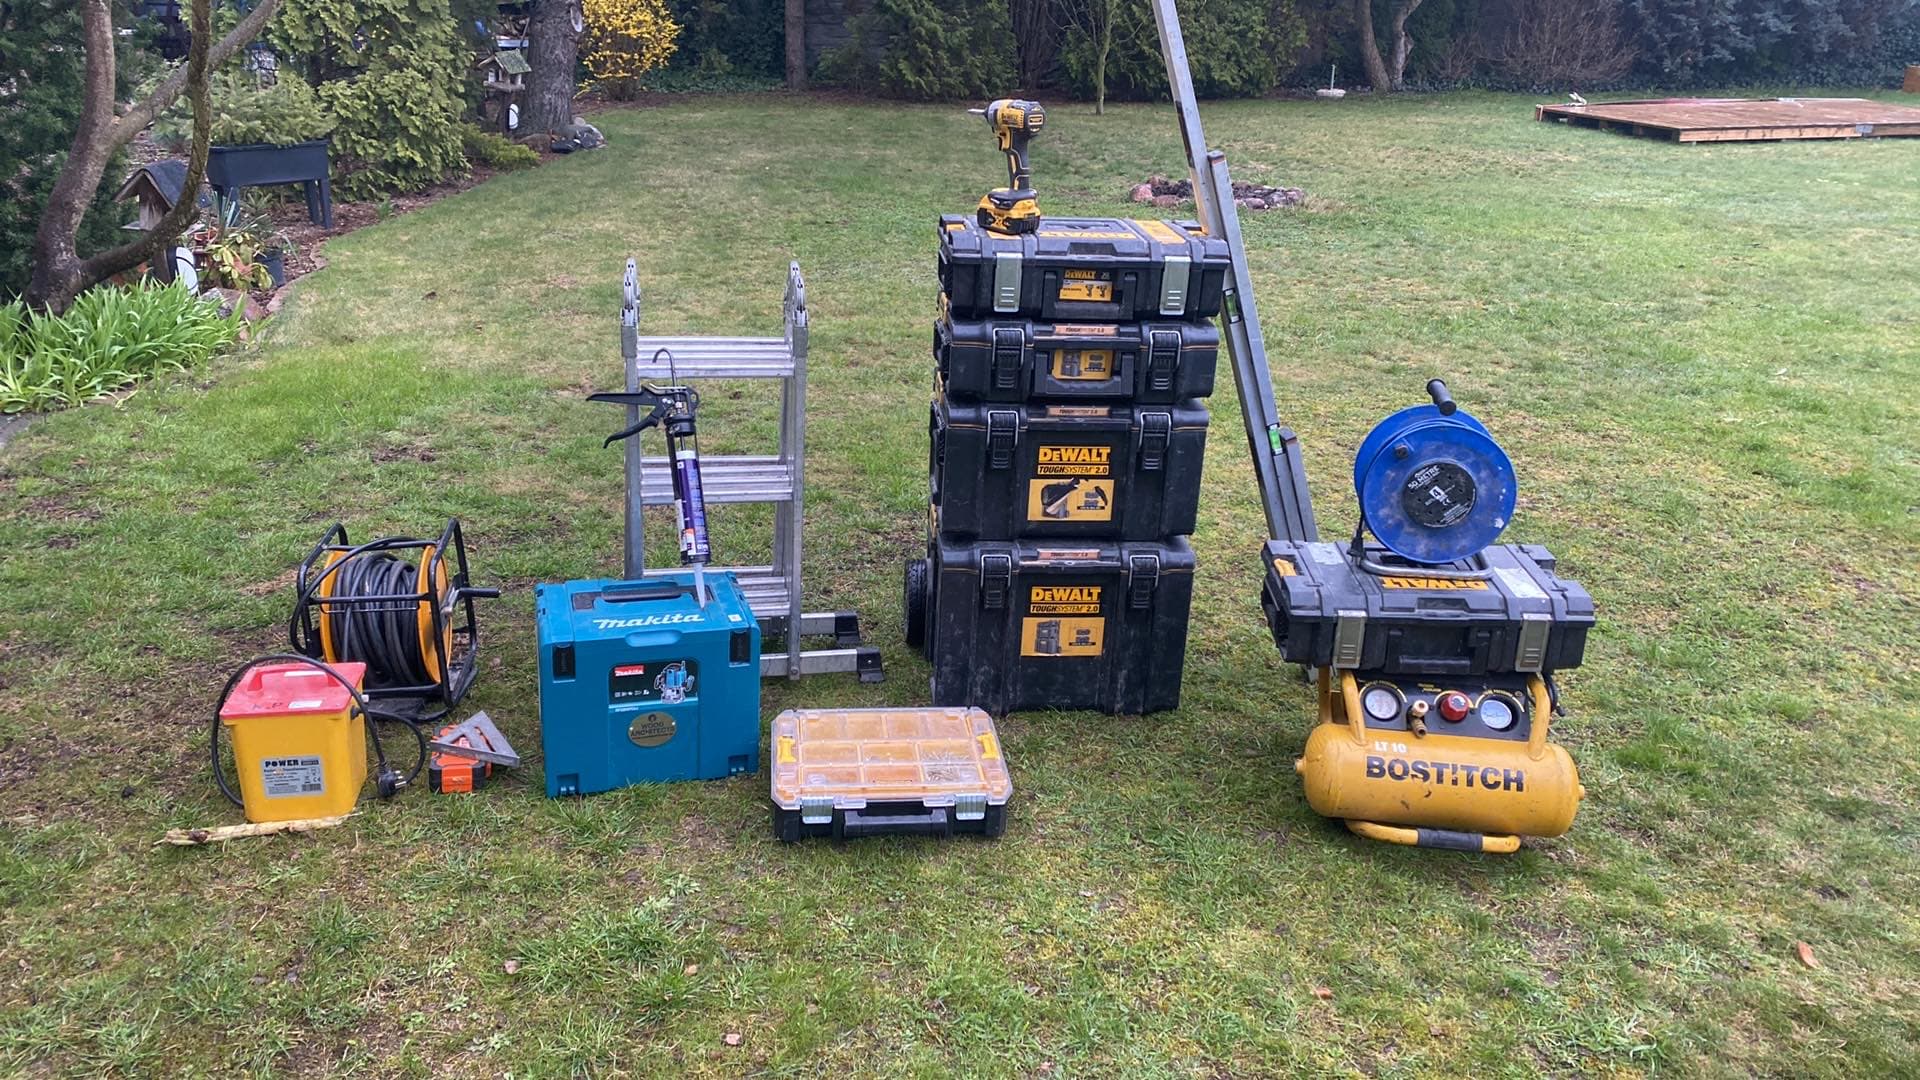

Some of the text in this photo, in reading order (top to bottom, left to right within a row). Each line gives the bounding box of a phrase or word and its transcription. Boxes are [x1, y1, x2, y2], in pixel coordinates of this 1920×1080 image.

[1039, 447, 1111, 462] DEWALT
[1031, 587, 1101, 602] DEWALT
[641, 721, 665, 730] WOOD
[1375, 741, 1407, 753] LT 10
[265, 759, 299, 767] POWER
